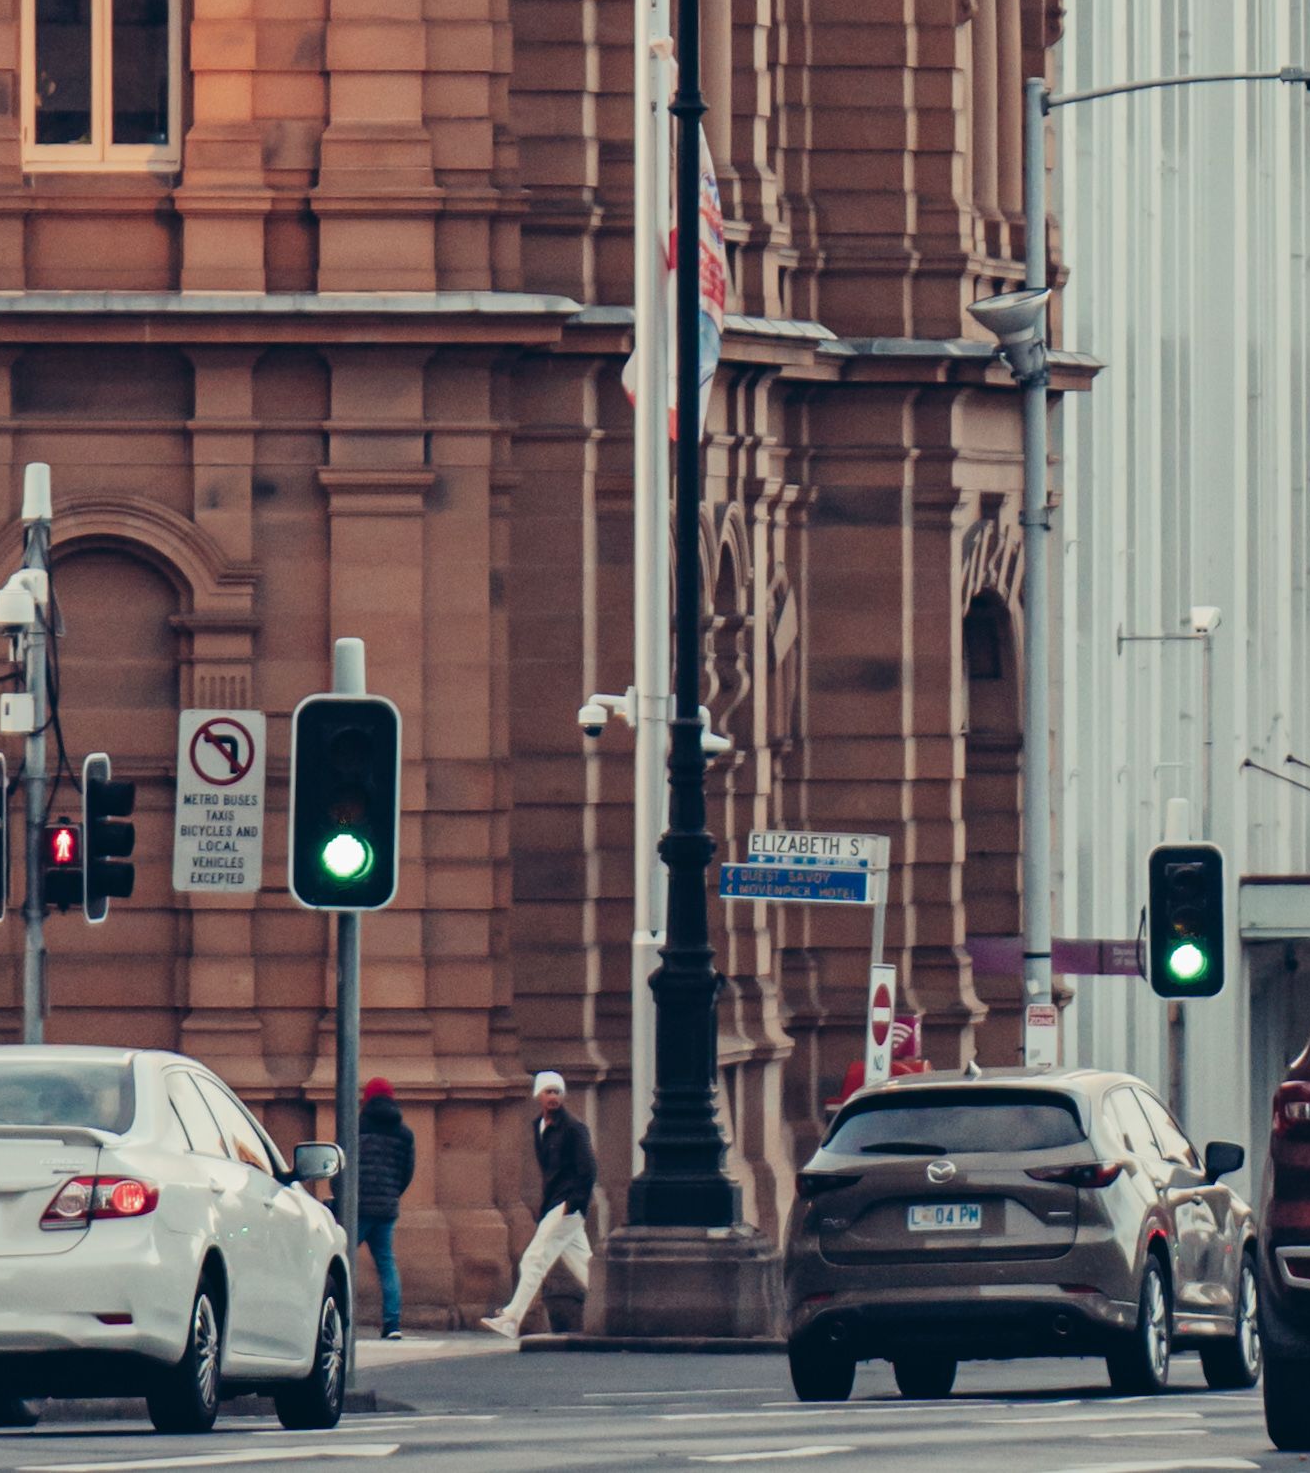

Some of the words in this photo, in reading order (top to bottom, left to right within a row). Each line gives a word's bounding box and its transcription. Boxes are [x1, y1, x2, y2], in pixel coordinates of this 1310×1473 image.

[183, 794, 219, 806] METRO
[224, 794, 258, 806] BUSES
[206, 810, 235, 821] TAXIS
[181, 825, 232, 837] BICYCLES
[236, 826, 258, 837] AND
[198, 841, 239, 852] LOCAL
[752, 834, 840, 855] ELIZABETH
[192, 857, 244, 868] VEHICLES
[190, 872, 245, 884] EXCEPTED
[819, 888, 858, 900] HOTEL
